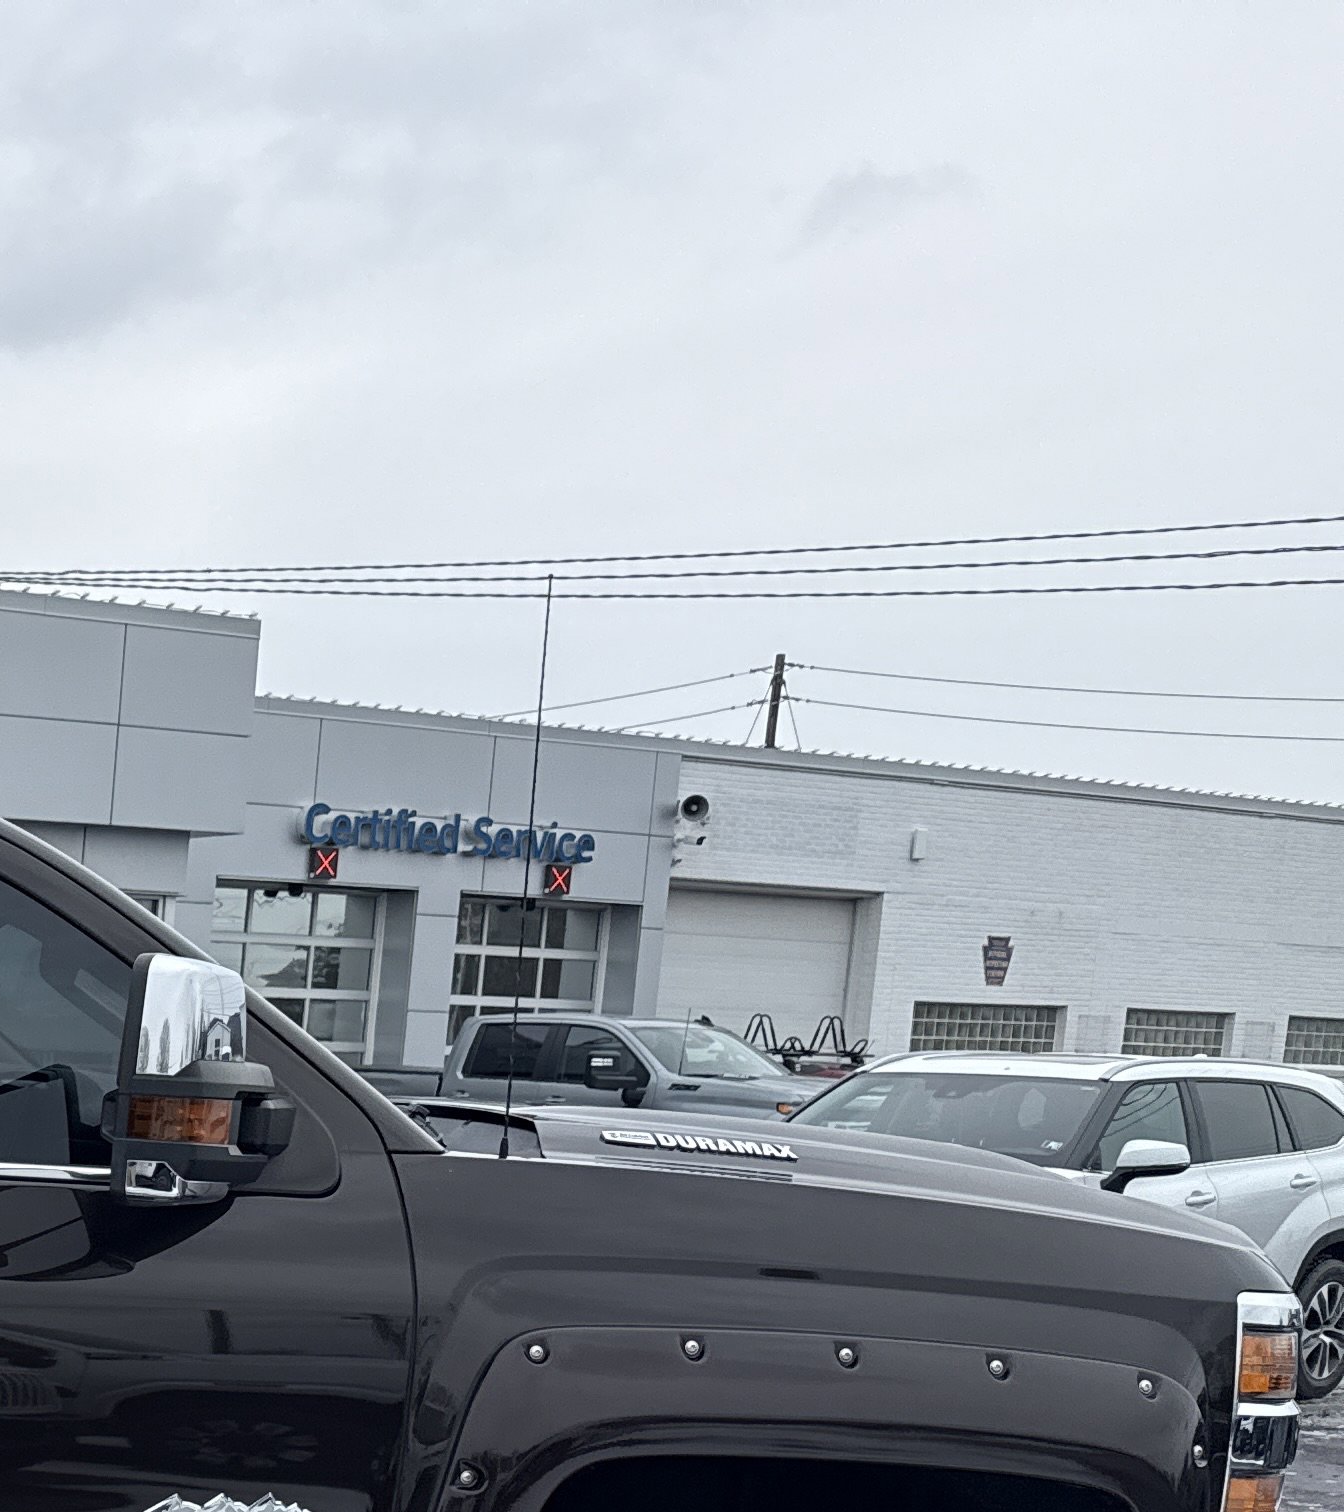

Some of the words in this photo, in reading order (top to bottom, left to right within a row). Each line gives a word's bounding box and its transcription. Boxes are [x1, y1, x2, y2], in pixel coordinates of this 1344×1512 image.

[304, 803, 461, 855] Certified
[473, 816, 595, 863] Service
[654, 1132, 799, 1162] DURAMAX
